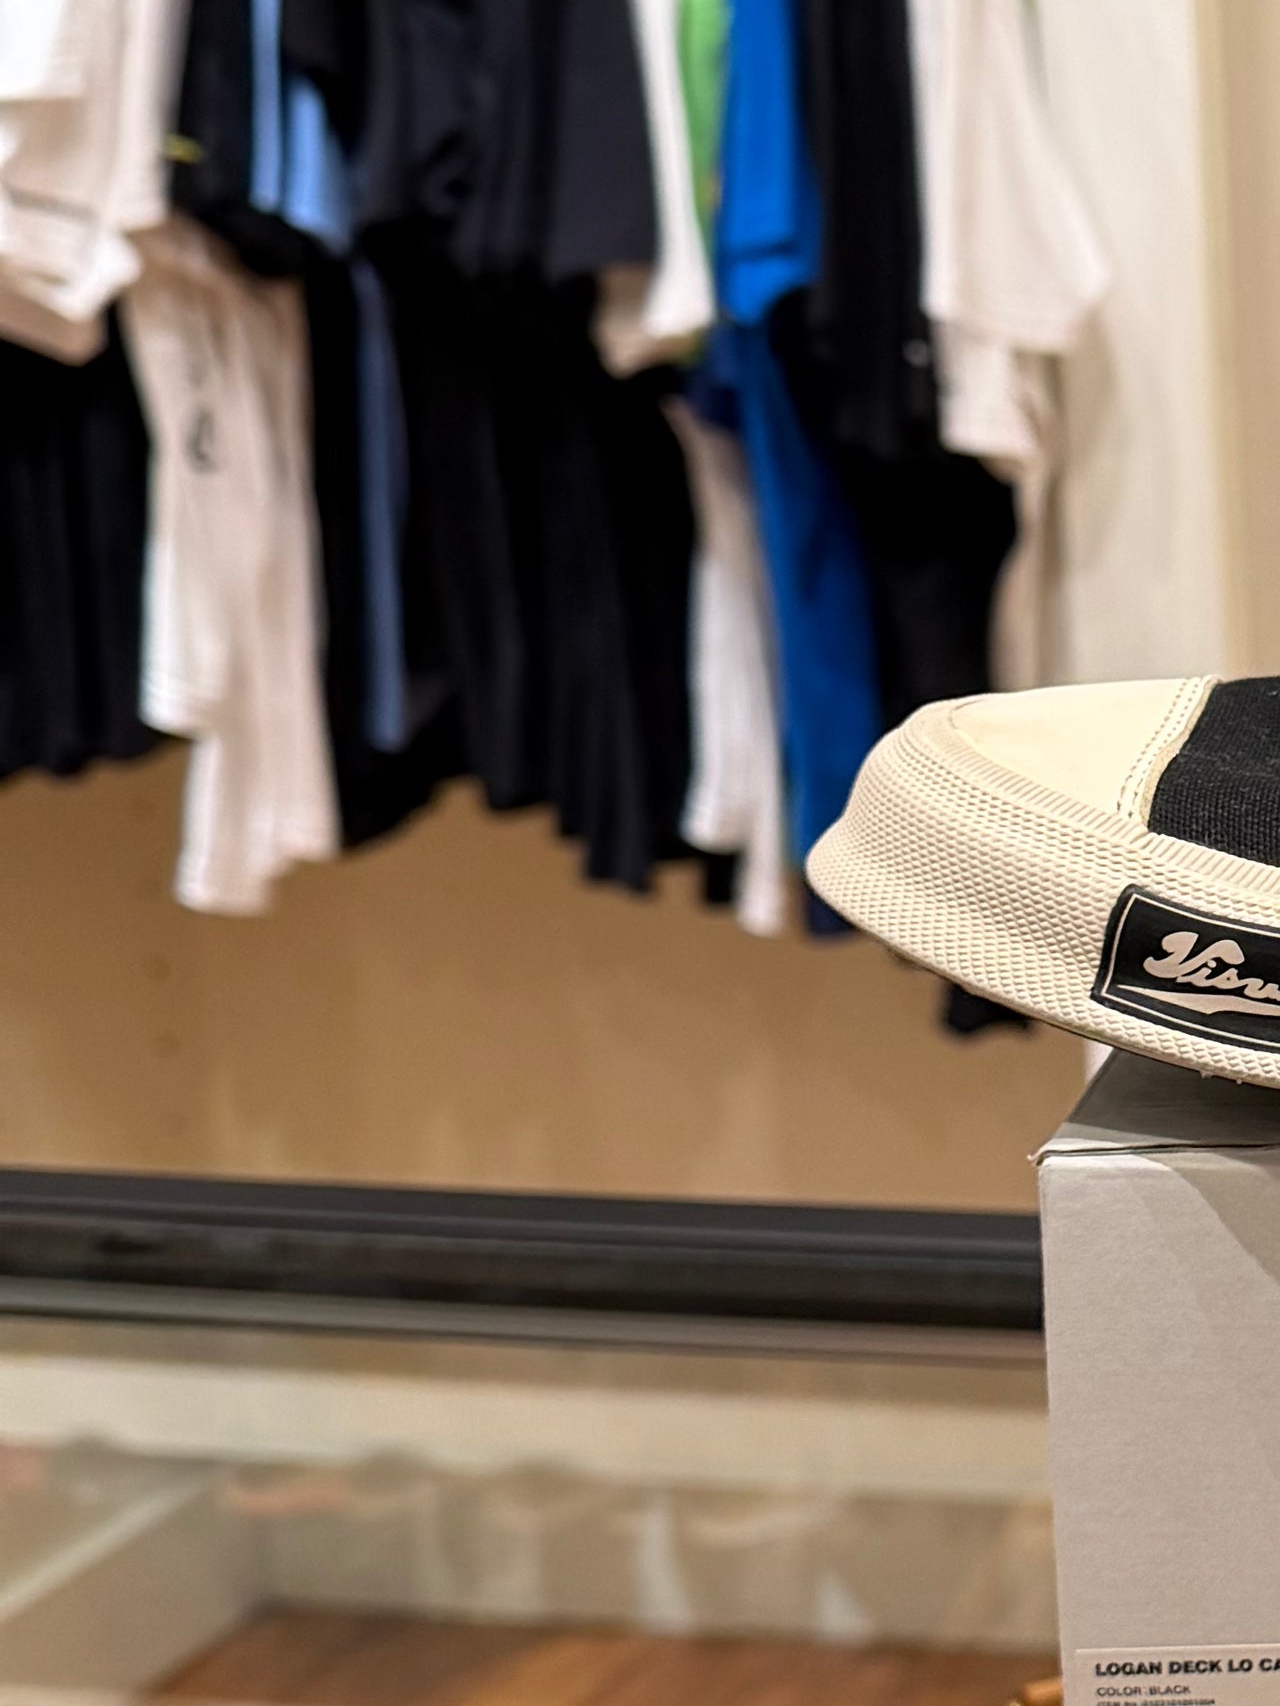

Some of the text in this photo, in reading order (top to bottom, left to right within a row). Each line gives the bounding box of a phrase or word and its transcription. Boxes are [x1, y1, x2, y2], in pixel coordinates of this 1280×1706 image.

[1094, 1661, 1162, 1678] LOGAN
[1168, 1660, 1223, 1675] DECK
[1228, 1659, 1256, 1673] LO
